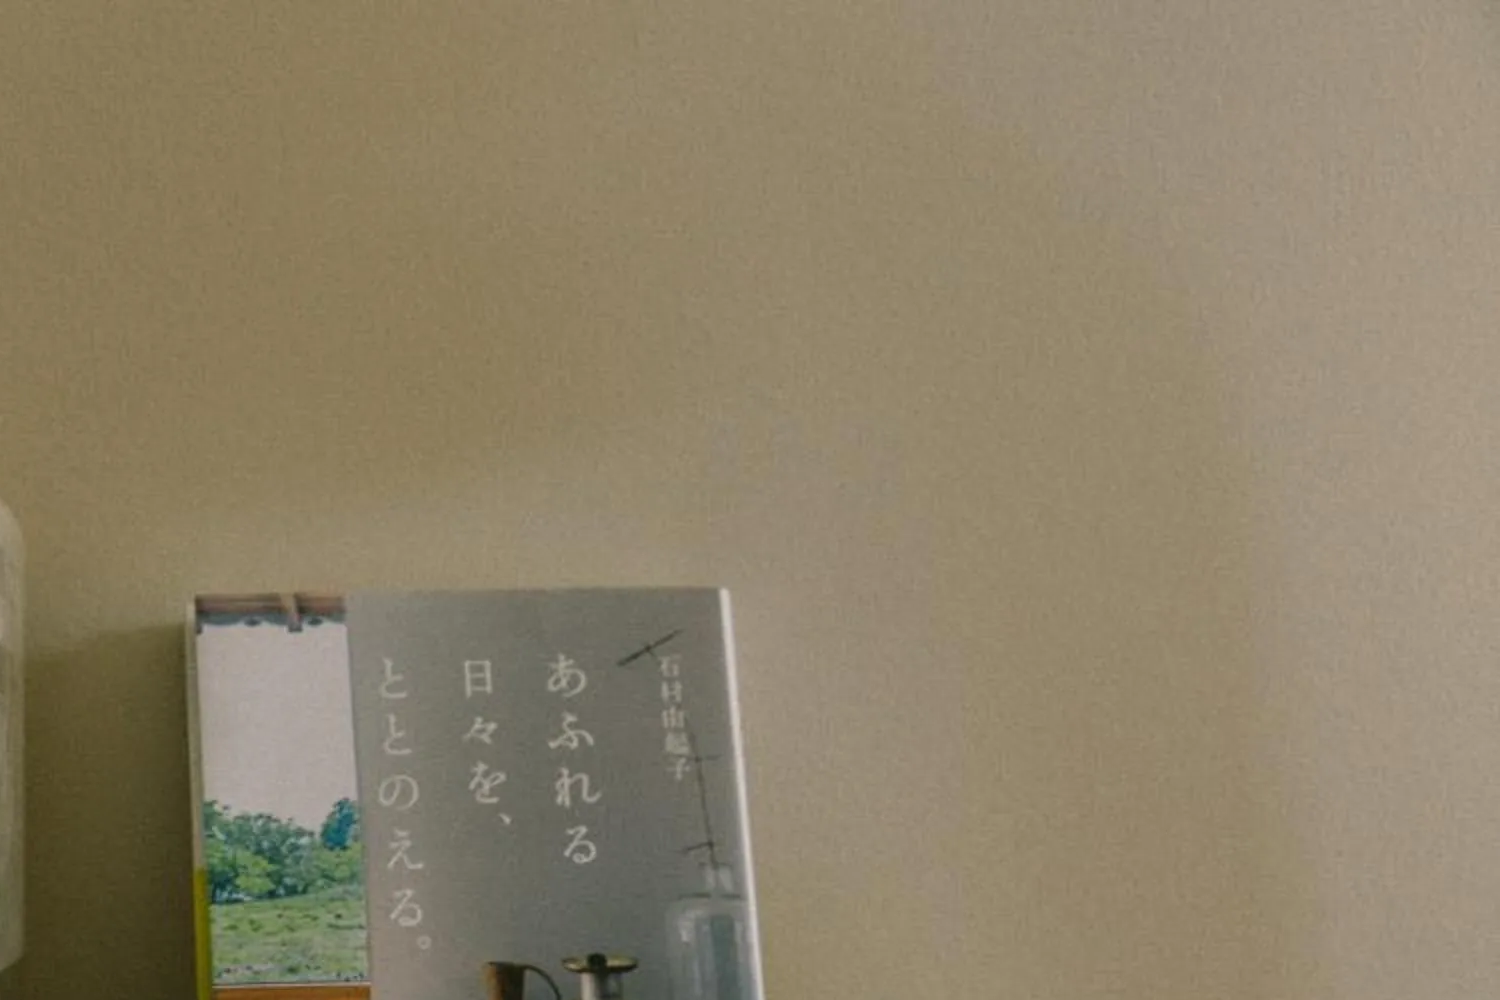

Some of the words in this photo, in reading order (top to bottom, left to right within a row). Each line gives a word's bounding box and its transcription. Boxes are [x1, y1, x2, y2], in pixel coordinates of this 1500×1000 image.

[377, 657, 433, 950] ととのえる。
[461, 658, 513, 826] 日々を、
[547, 653, 603, 865] あふれる
